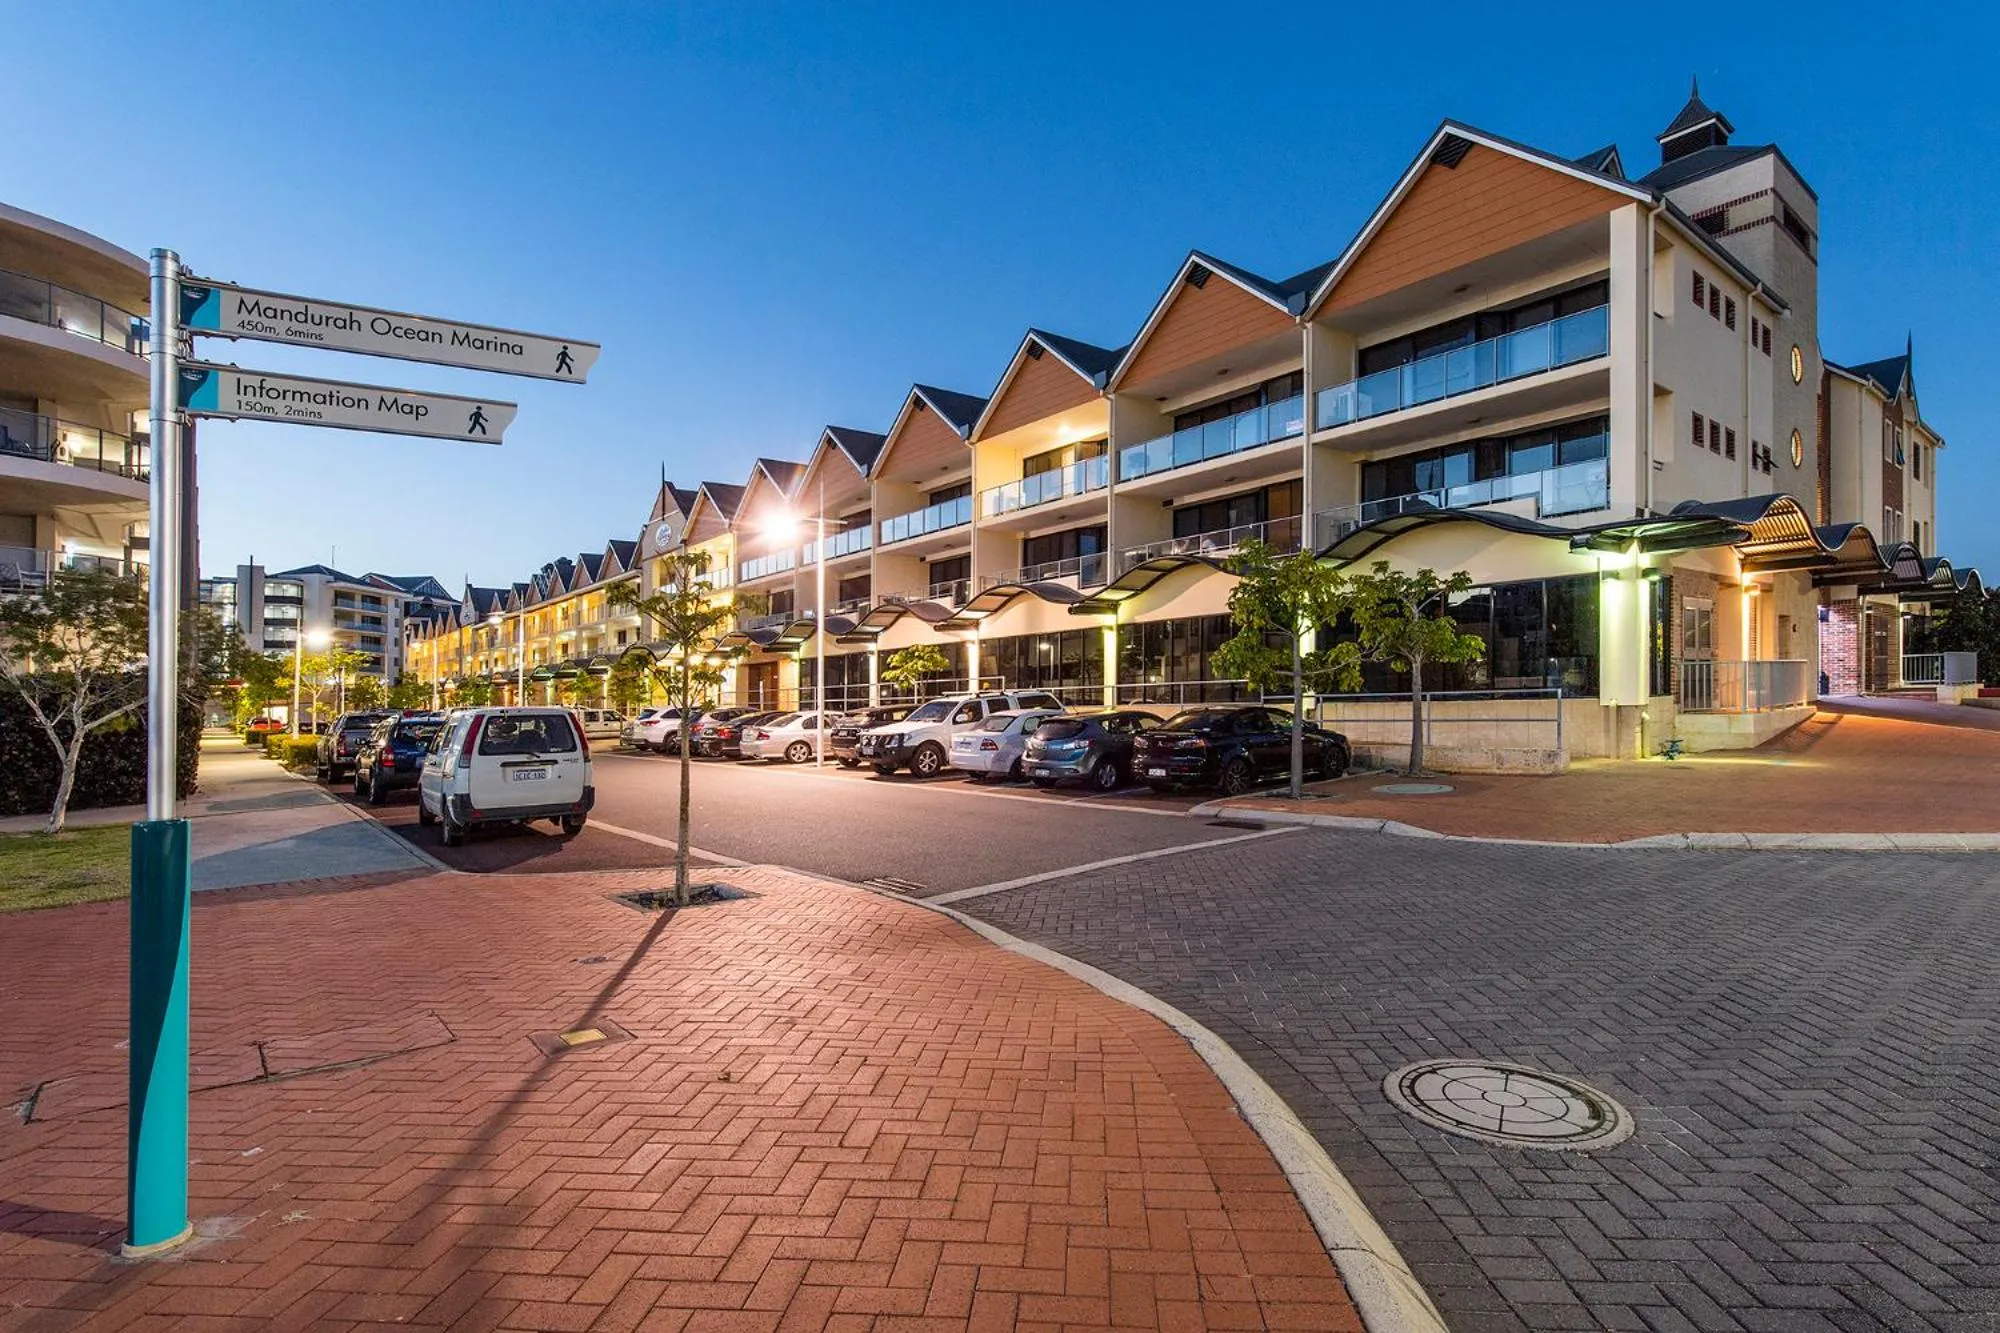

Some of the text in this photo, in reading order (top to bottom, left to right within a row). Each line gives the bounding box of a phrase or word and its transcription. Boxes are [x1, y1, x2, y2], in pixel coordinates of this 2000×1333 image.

[236, 320, 324, 341] 450m, 6mins
[237, 296, 524, 356] Mandurah Ocean Marina
[236, 377, 429, 421] Information Map
[236, 400, 323, 419] 150m, 2mins
